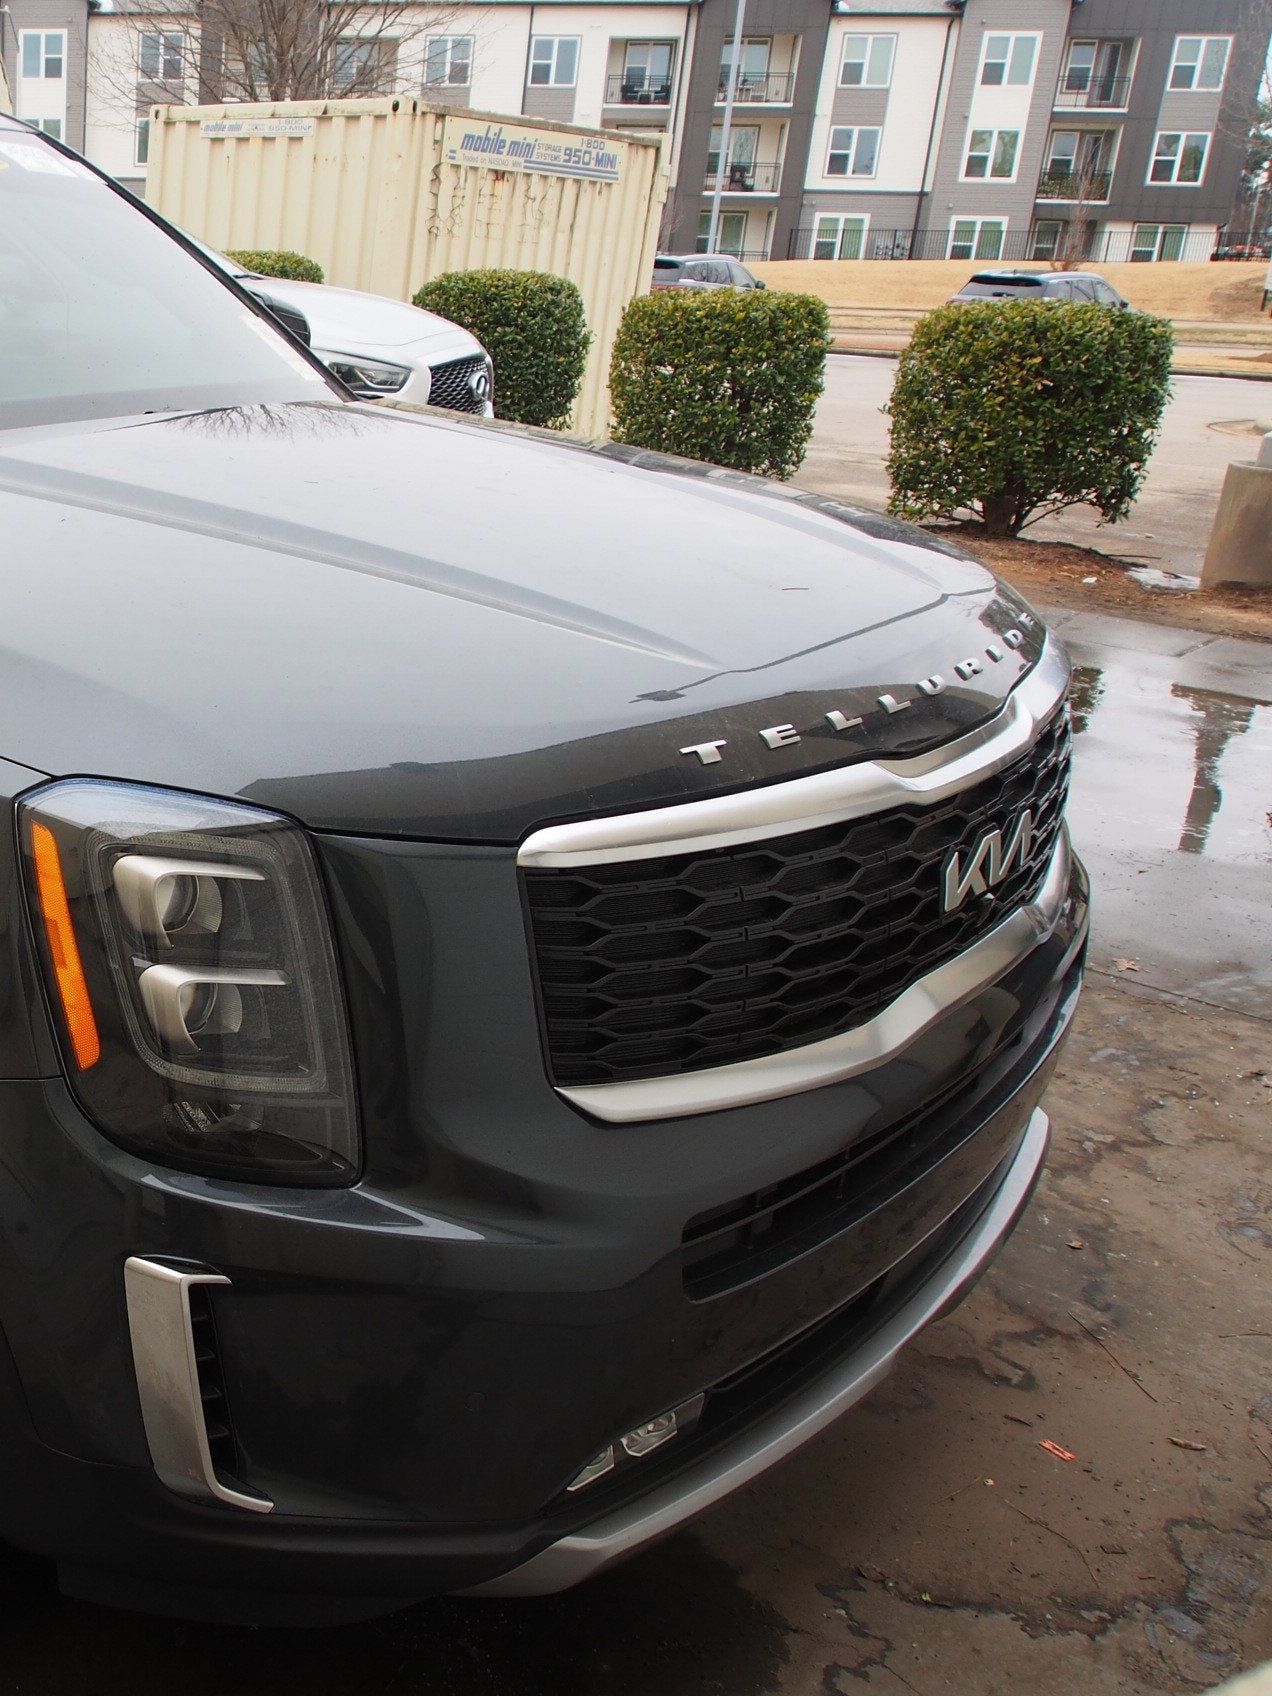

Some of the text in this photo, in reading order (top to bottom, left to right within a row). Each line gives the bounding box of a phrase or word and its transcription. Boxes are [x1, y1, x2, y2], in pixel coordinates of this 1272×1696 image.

[460, 124, 538, 159] mobile mini
[536, 142, 562, 153] STORAGE
[536, 151, 562, 162] SYSTEMS
[679, 611, 1035, 766] TELLURIDE
[943, 809, 1031, 913] KIA
